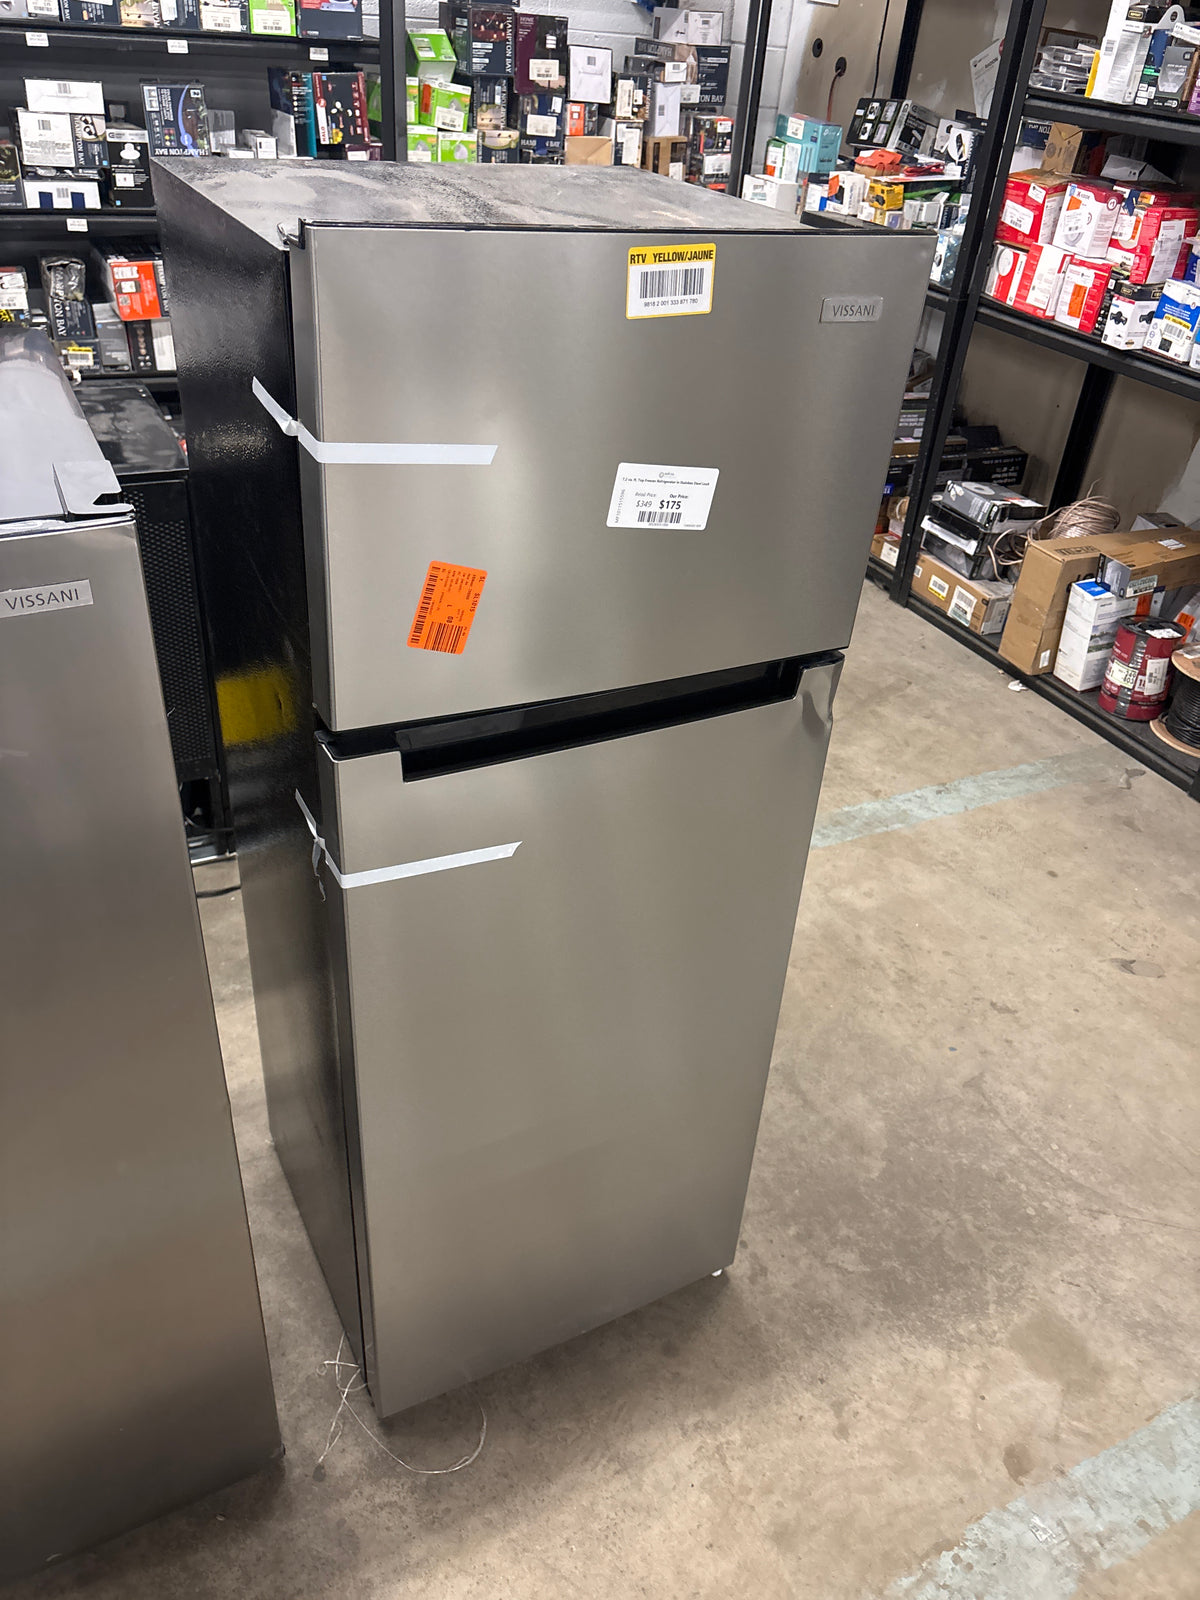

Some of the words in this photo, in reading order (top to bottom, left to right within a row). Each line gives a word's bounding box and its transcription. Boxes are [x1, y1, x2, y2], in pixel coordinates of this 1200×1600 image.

[711, 95, 724, 103] BAY
[630, 254, 647, 264] RTV
[653, 250, 714, 262] YELLOW/JAUNE
[833, 304, 875, 317] VISSANI
[56, 319, 67, 336] BAY
[636, 500, 652, 508] $349
[659, 500, 681, 510] $175
[5, 588, 79, 610] VISSANI
